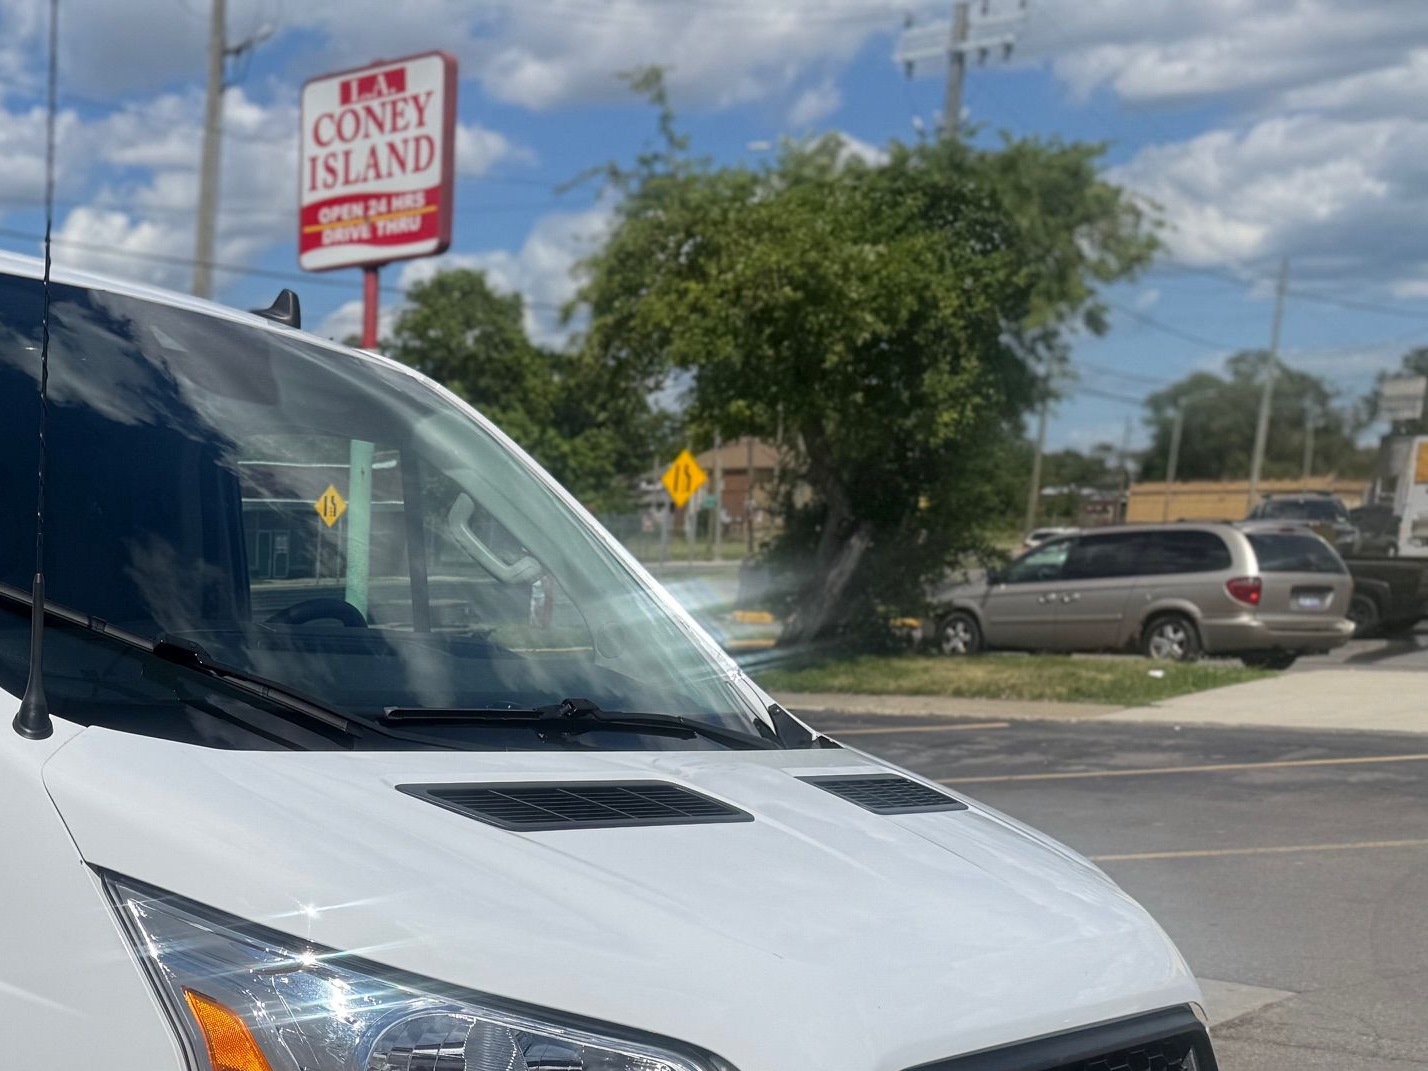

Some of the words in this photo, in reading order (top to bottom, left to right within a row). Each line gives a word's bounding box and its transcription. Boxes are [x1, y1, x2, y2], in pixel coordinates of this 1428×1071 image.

[312, 92, 434, 147] CONEY
[308, 135, 436, 192] ISLAND
[318, 200, 365, 224] OPEN
[390, 190, 425, 211] HRS
[322, 223, 371, 245] DRIVE
[376, 213, 421, 237] THRU
